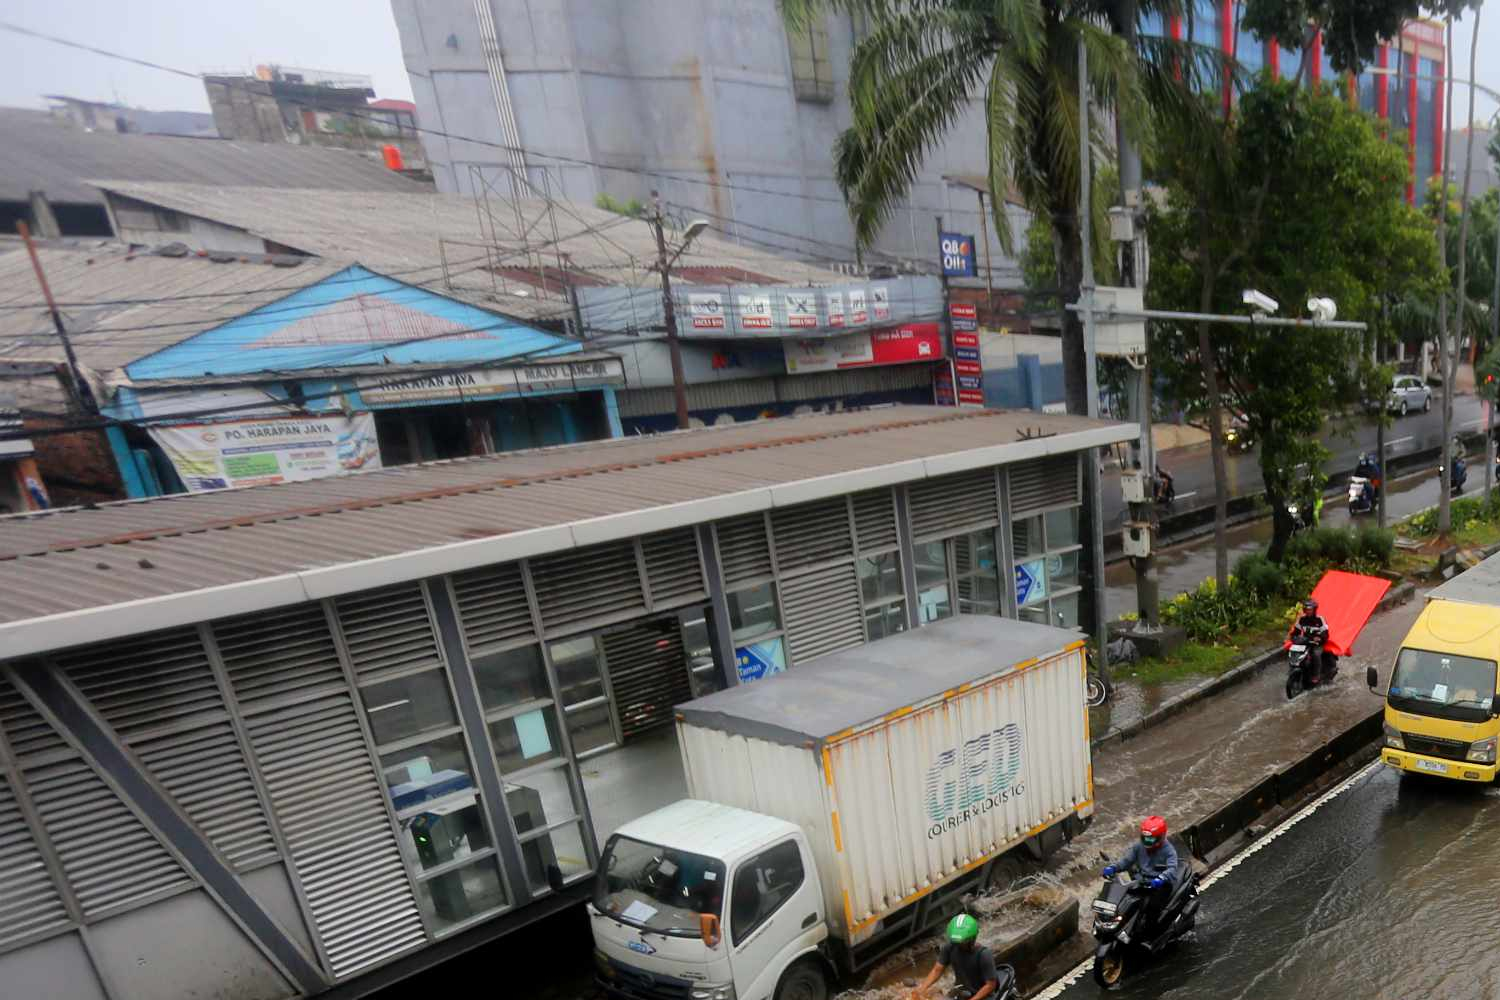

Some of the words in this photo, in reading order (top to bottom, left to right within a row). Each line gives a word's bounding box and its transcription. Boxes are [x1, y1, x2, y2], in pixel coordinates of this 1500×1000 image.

[447, 373, 476, 386] JAYA
[525, 365, 558, 380] MAJU
[247, 425, 300, 438] HARAPAN
[305, 423, 331, 435] JAYA
